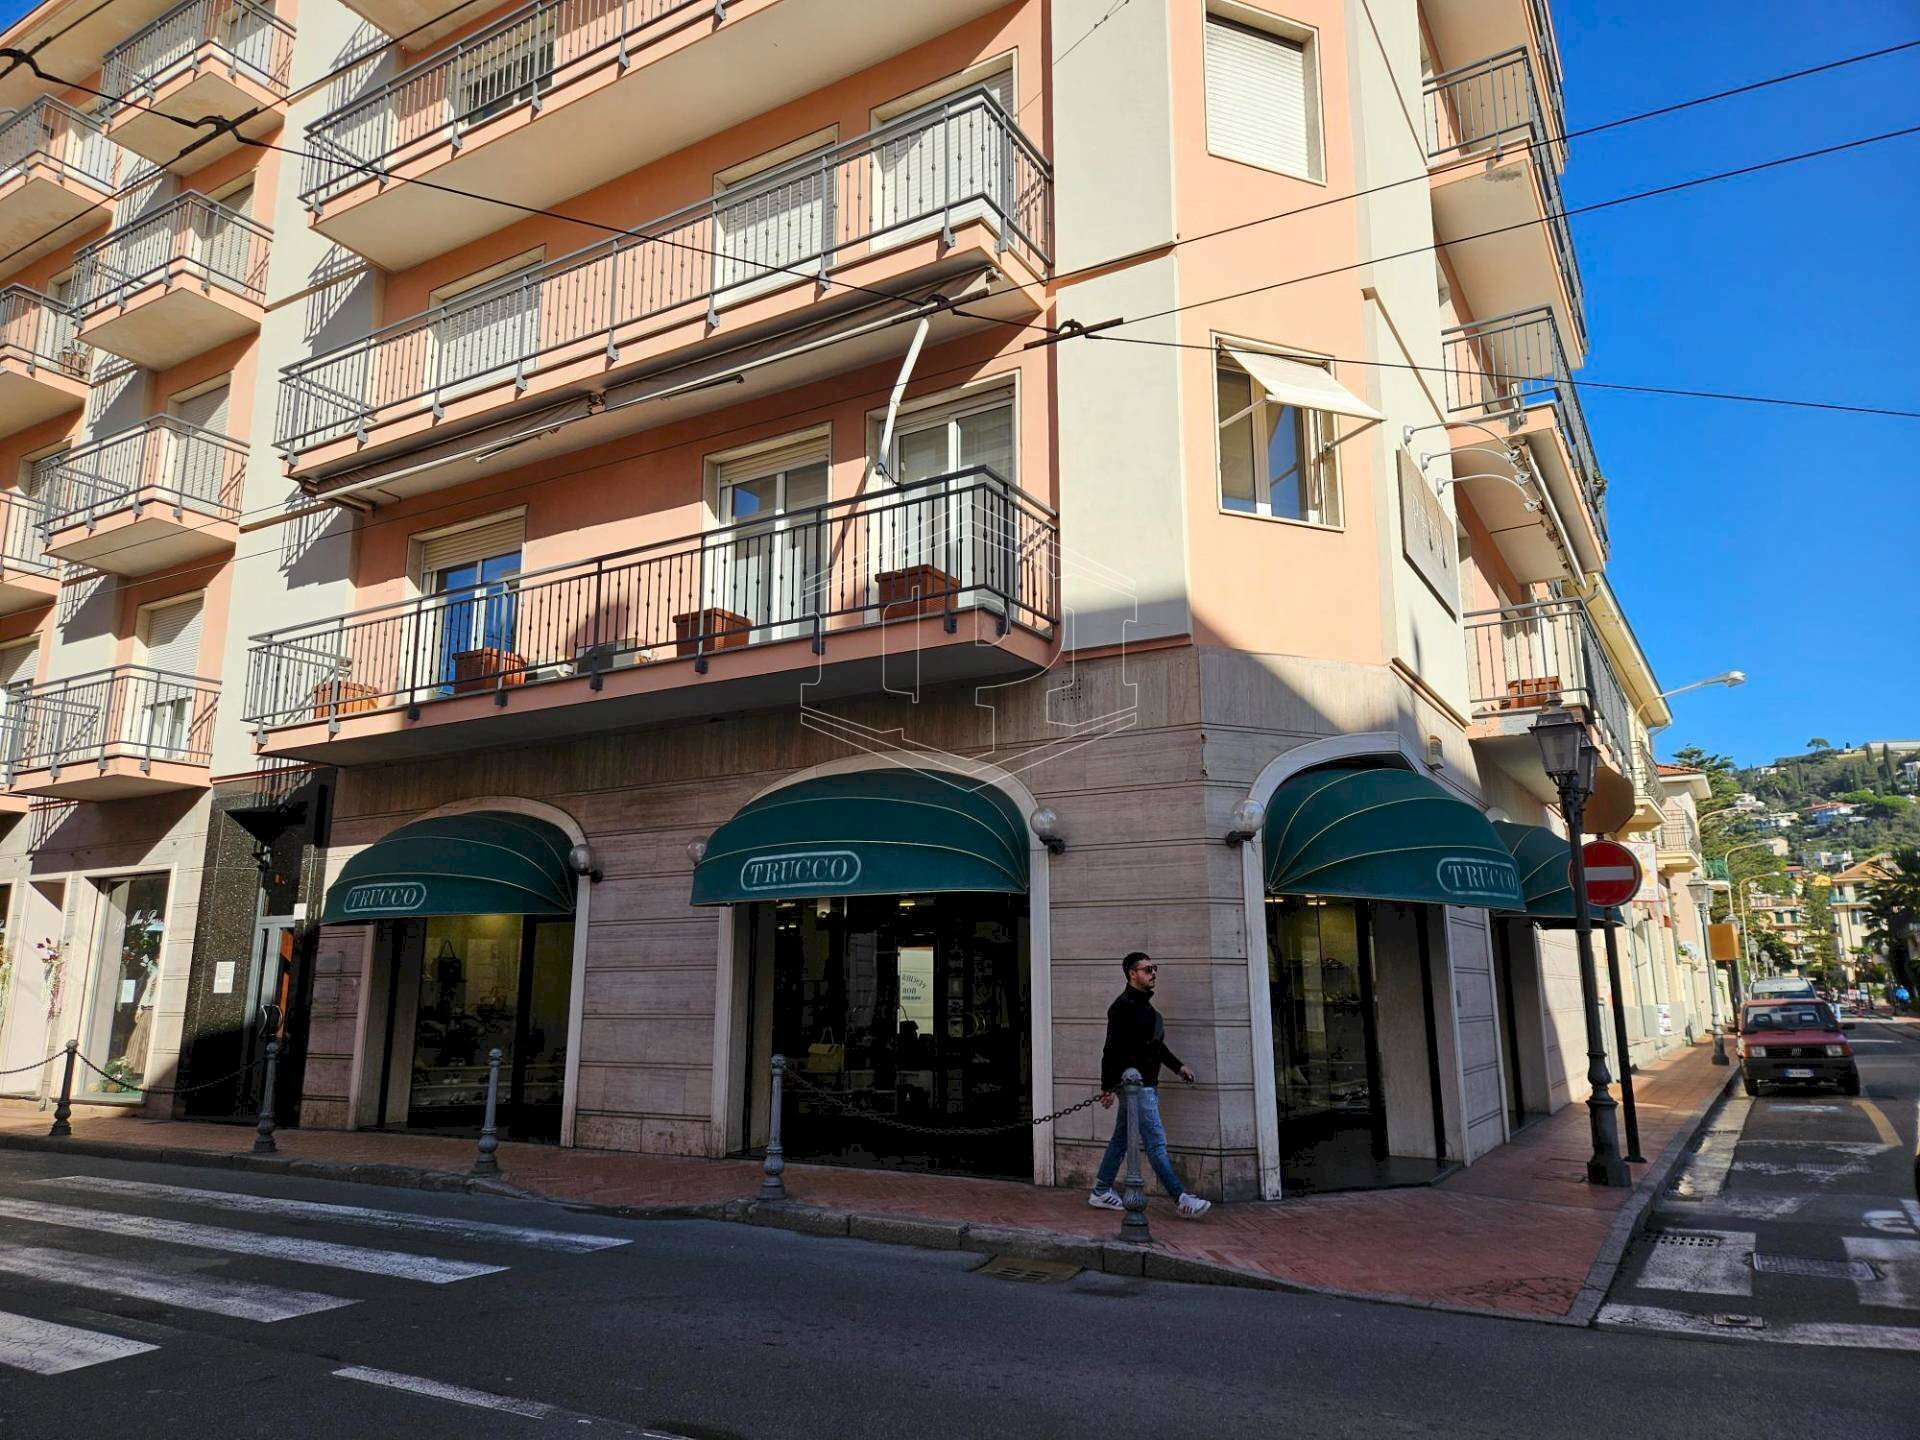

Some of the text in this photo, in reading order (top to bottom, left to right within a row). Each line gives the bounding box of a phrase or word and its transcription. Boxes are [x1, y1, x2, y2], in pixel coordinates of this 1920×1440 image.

[750, 857, 848, 884] TRUCCO
[1447, 865, 1516, 890] TRUCCO
[351, 887, 417, 908] TRUCCO
